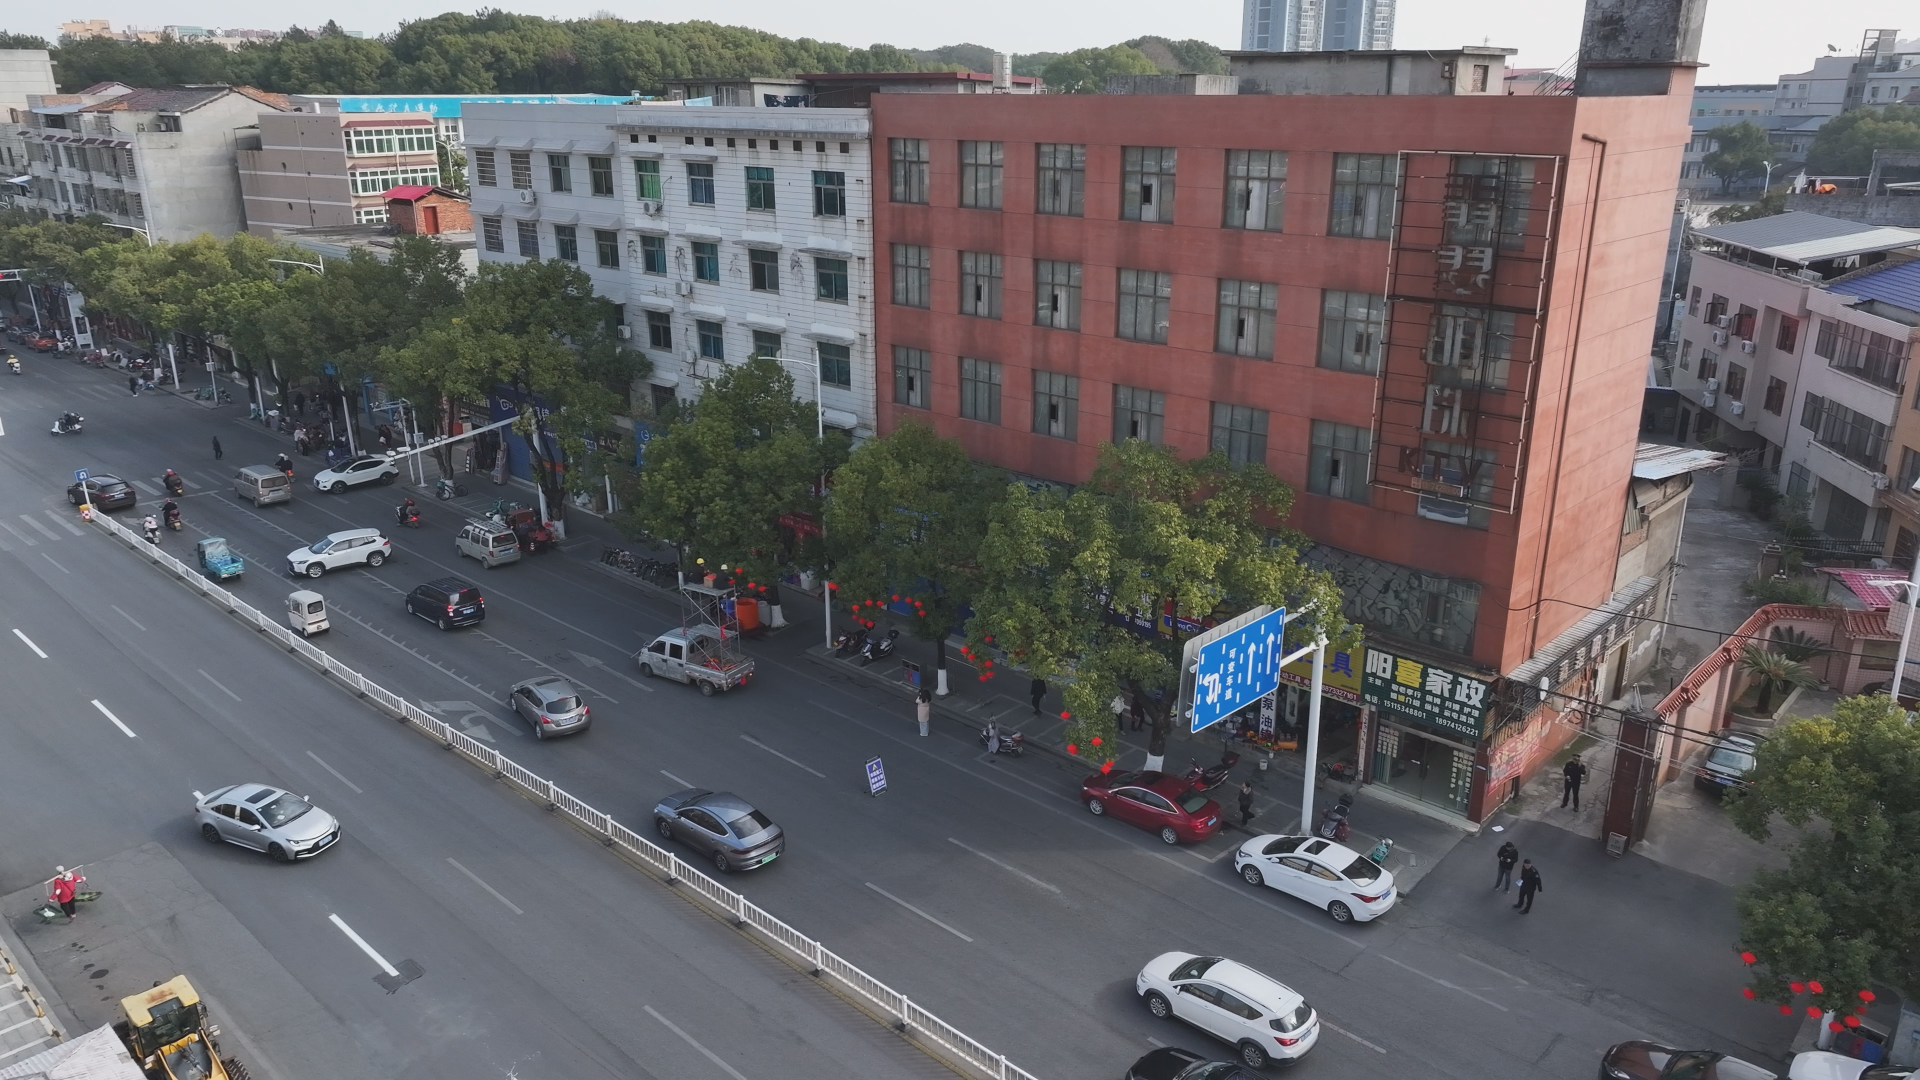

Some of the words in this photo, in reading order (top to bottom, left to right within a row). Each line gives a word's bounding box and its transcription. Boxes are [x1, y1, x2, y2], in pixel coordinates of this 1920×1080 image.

[1397, 445, 1484, 484] KTV
[1353, 595, 1425, 634] KTV
[1224, 647, 1237, 701] 可变车道
[1365, 648, 1487, 709] 阳喜家政
[1435, 716, 1479, 737] 18974126221
